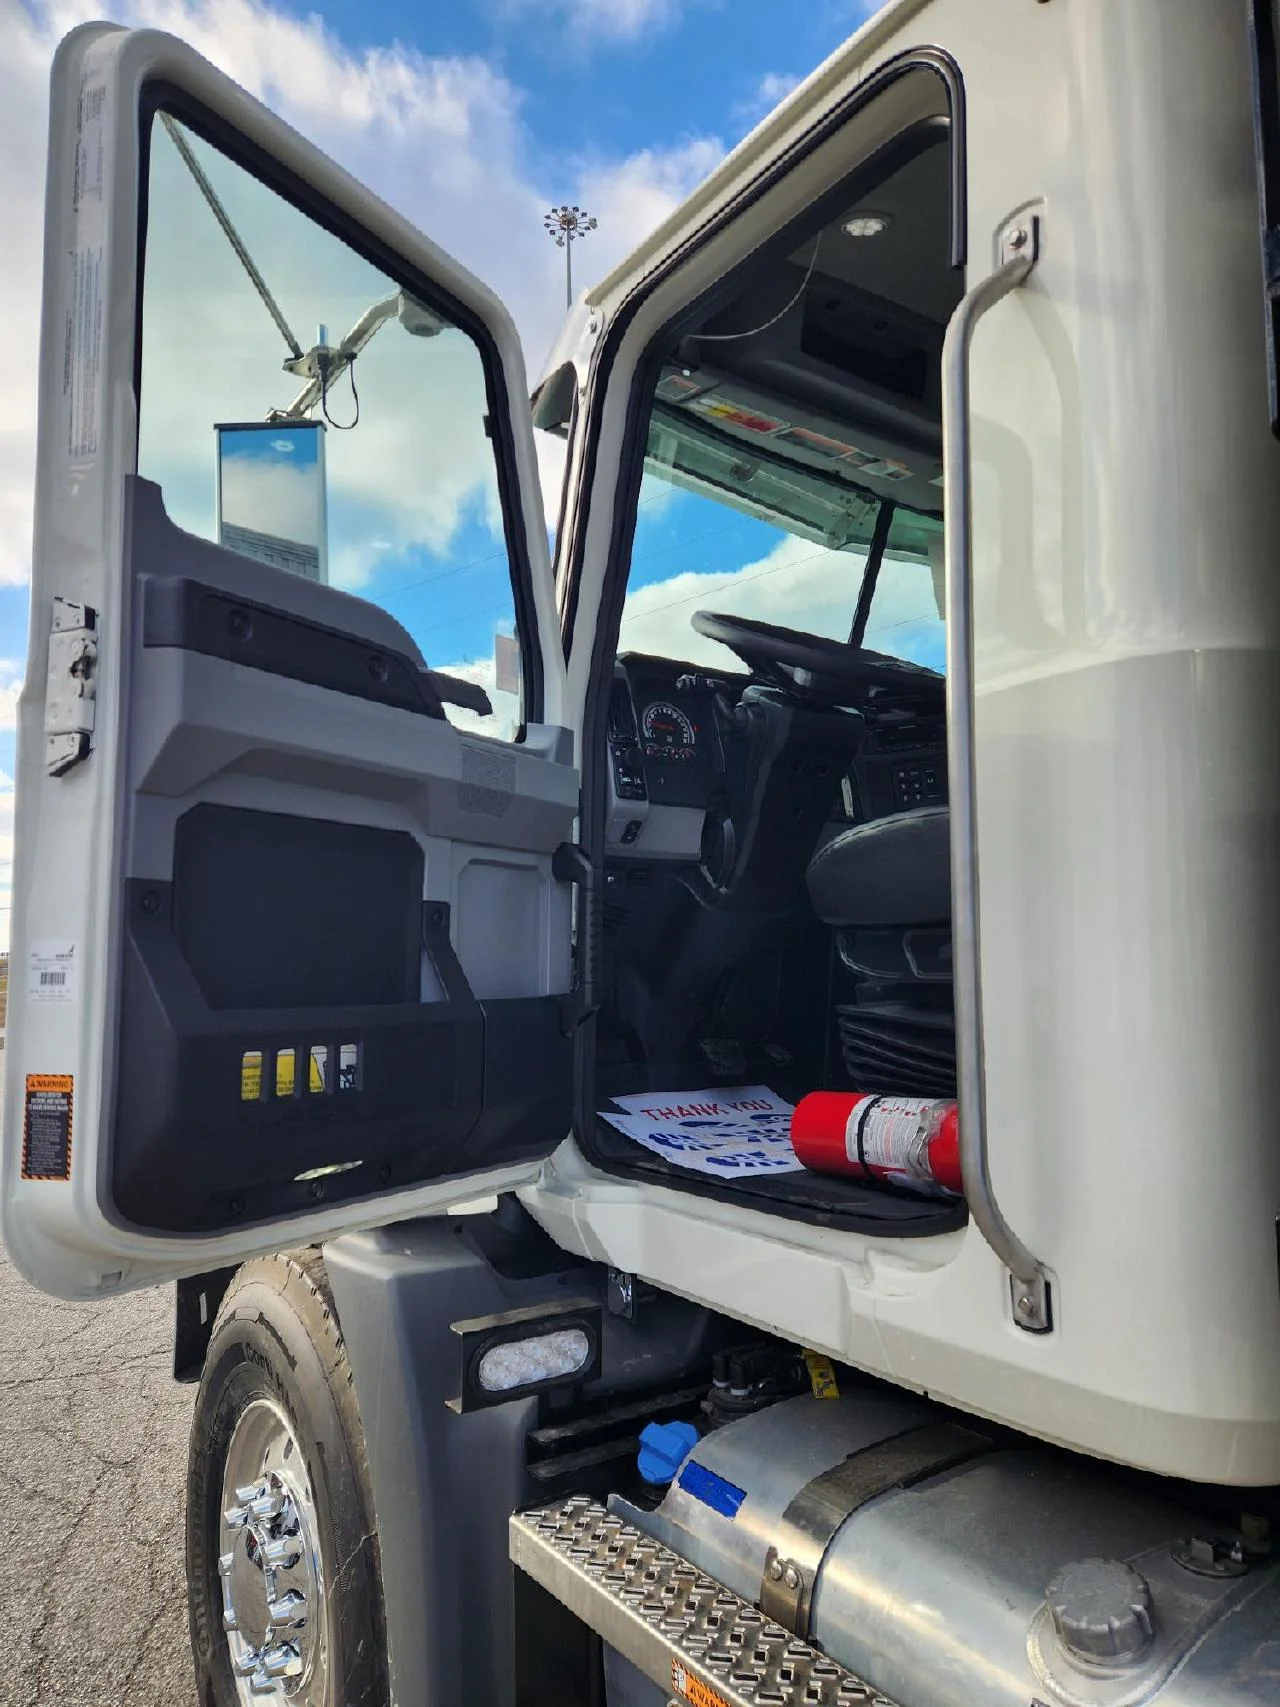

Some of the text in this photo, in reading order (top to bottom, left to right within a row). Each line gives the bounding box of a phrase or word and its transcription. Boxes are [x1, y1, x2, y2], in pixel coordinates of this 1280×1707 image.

[37, 1080, 69, 1088] WARNING
[640, 1100, 773, 1120] THANK YOU
